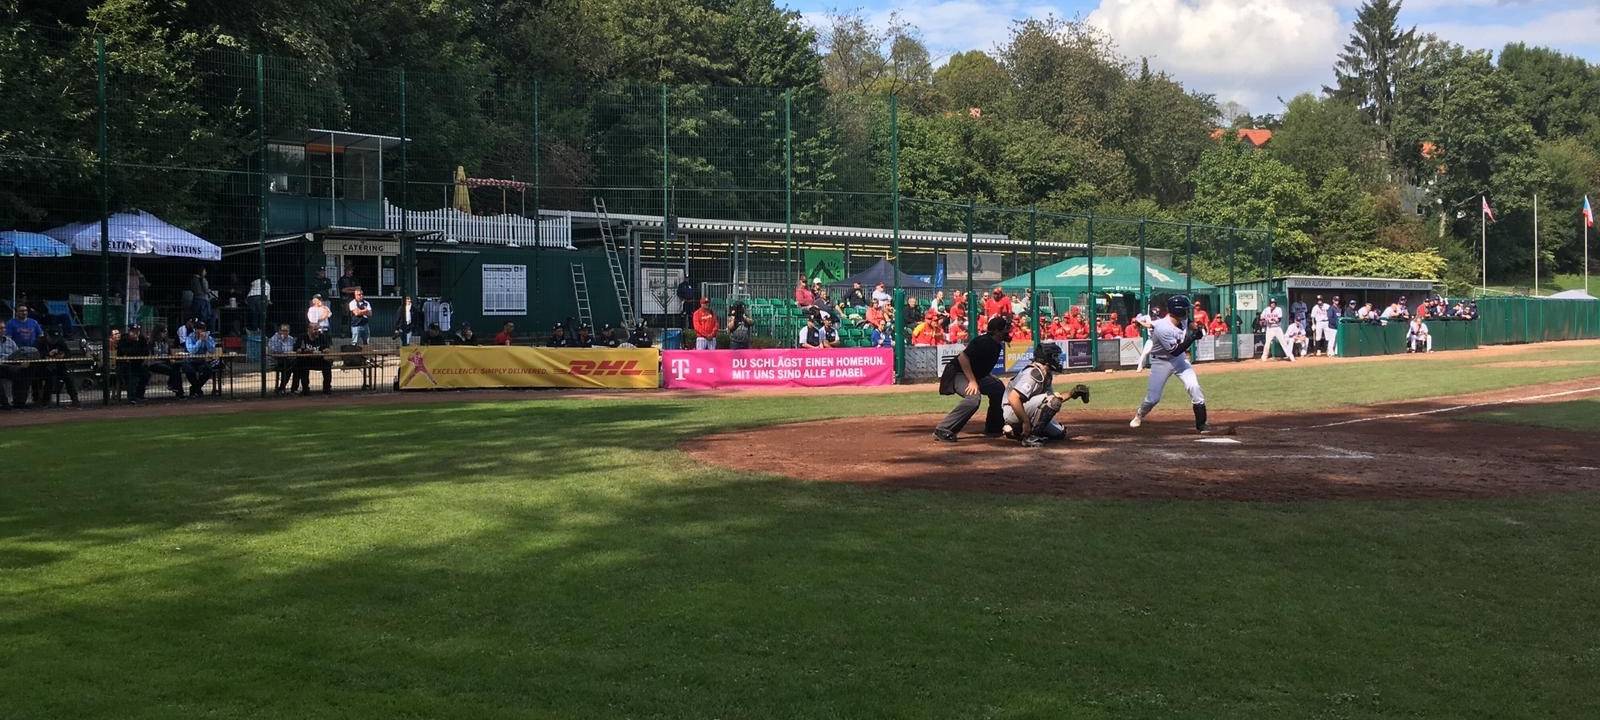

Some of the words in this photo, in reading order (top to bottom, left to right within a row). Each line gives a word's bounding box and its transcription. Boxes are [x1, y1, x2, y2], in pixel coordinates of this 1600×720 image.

[107, 241, 137, 250] ELTINS
[172, 244, 202, 255] VELTINS
[342, 244, 385, 252] CATERING
[1007, 351, 1034, 361] PRAGER
[732, 357, 747, 368] DU
[749, 355, 802, 368] SCHLÄGST
[805, 357, 834, 367] EINEN
[836, 356, 886, 366] HOMERUN.
[480, 367, 507, 375] SIMPLY
[569, 360, 641, 375] DHL
[732, 369, 751, 379] MIT
[753, 369, 775, 379] UNS
[777, 369, 801, 379] SIND
[803, 368, 827, 379] ALLE
[829, 367, 866, 378] #DABEI.
